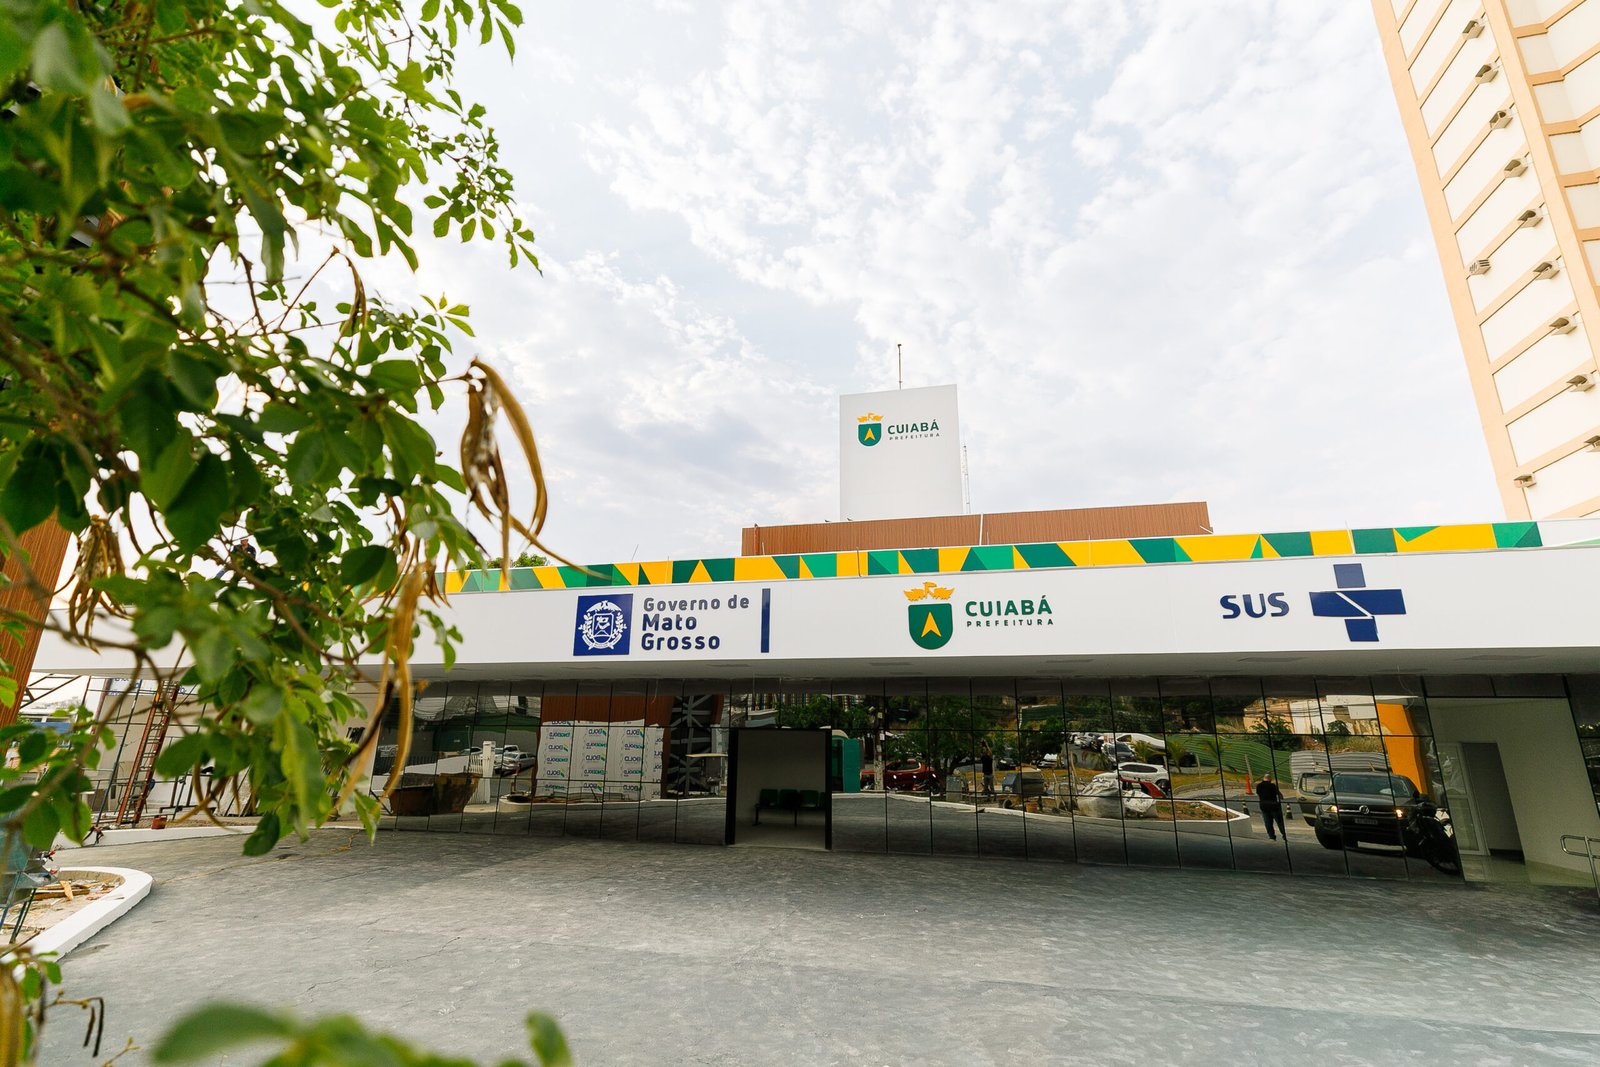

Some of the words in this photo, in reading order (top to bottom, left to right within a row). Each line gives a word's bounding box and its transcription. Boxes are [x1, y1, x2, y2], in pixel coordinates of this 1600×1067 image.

[887, 419, 940, 435] CUIABÁ
[643, 596, 721, 612] Governo
[727, 594, 750, 610] de
[965, 595, 1053, 617] CUIABÁ
[1219, 592, 1290, 620] SUS
[642, 613, 697, 631] Mato
[966, 618, 1054, 628] PREFEITURA
[641, 632, 721, 651] Grosso
